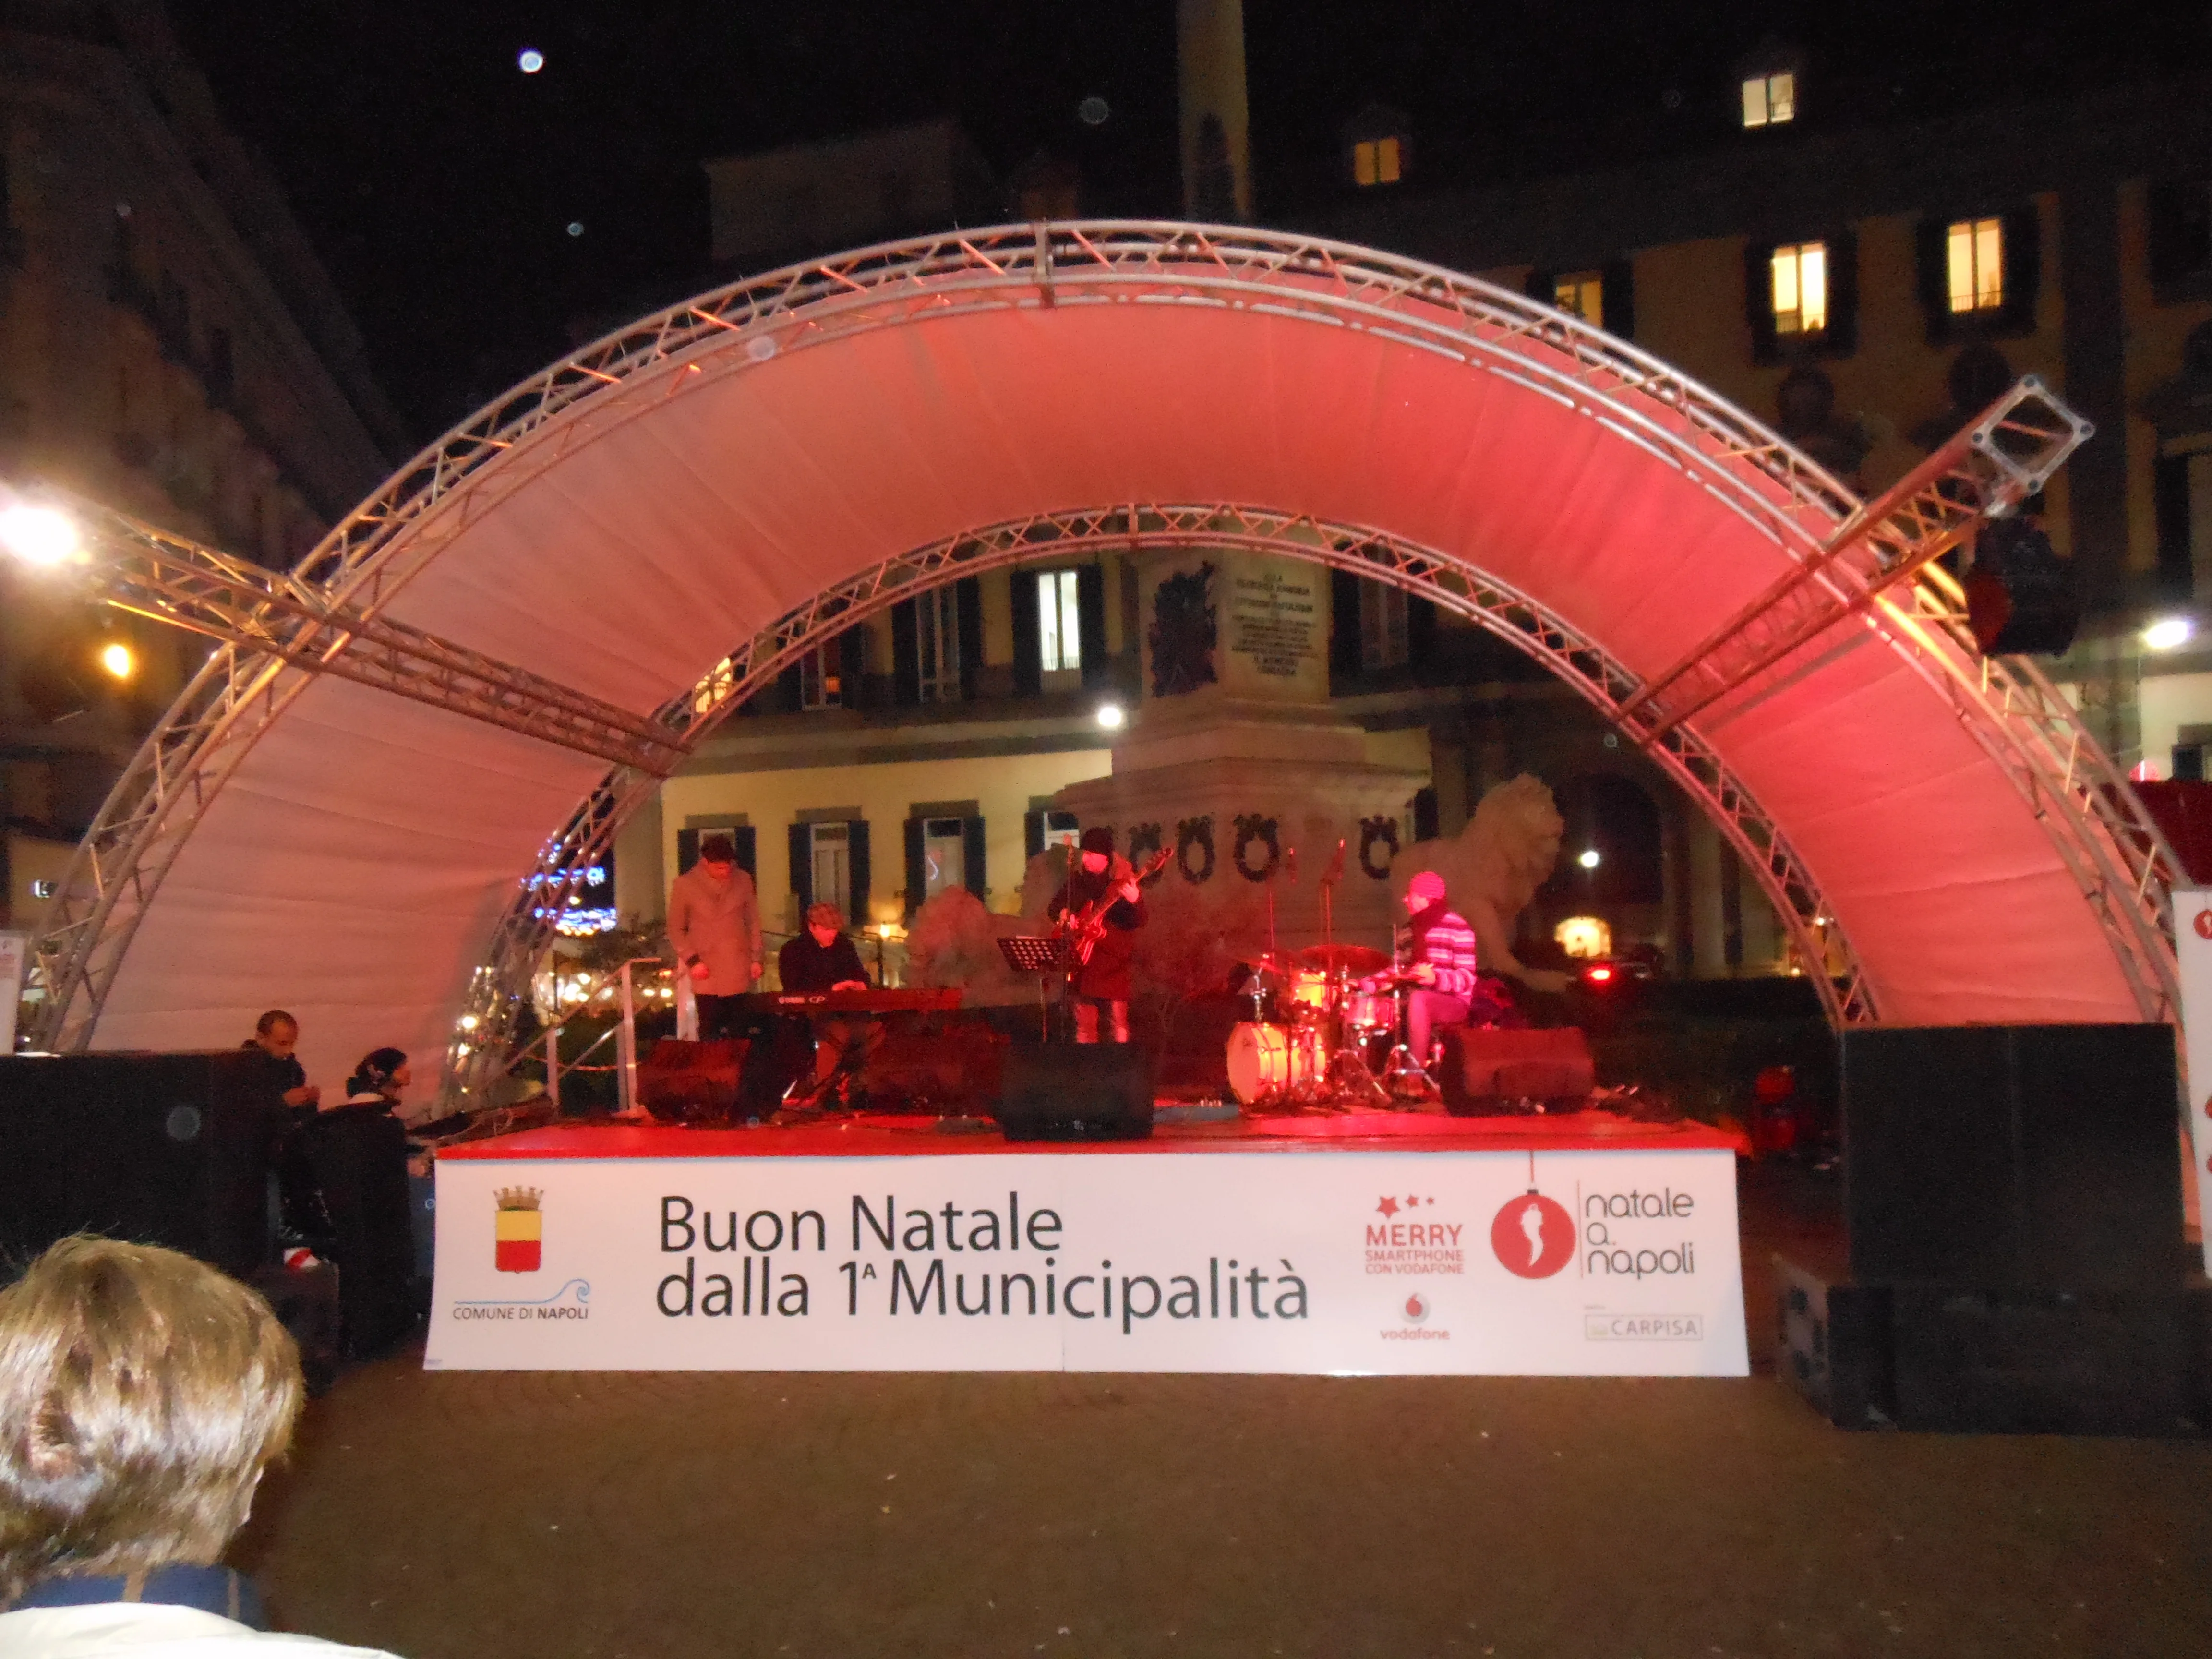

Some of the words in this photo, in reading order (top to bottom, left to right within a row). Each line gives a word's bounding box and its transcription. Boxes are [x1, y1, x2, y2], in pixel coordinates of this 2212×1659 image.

[1586, 1187, 1694, 1218] natale
[661, 1195, 826, 1252] Buon
[852, 1190, 1063, 1251] Natale
[1366, 1224, 1463, 1246] MERRY
[1365, 1250, 1464, 1262] SMARTPHONE
[1587, 1242, 1695, 1281] napoli
[1365, 1263, 1392, 1274] CON
[1395, 1263, 1464, 1275] VODAFONE
[656, 1256, 809, 1317] dalla
[889, 1256, 1309, 1334] Municipalità
[453, 1307, 514, 1320] COMUNE
[519, 1307, 532, 1319] DI
[537, 1307, 589, 1320] NAPOLI
[1379, 1327, 1450, 1340] vodafone
[1611, 1320, 1697, 1336] CARPISA
